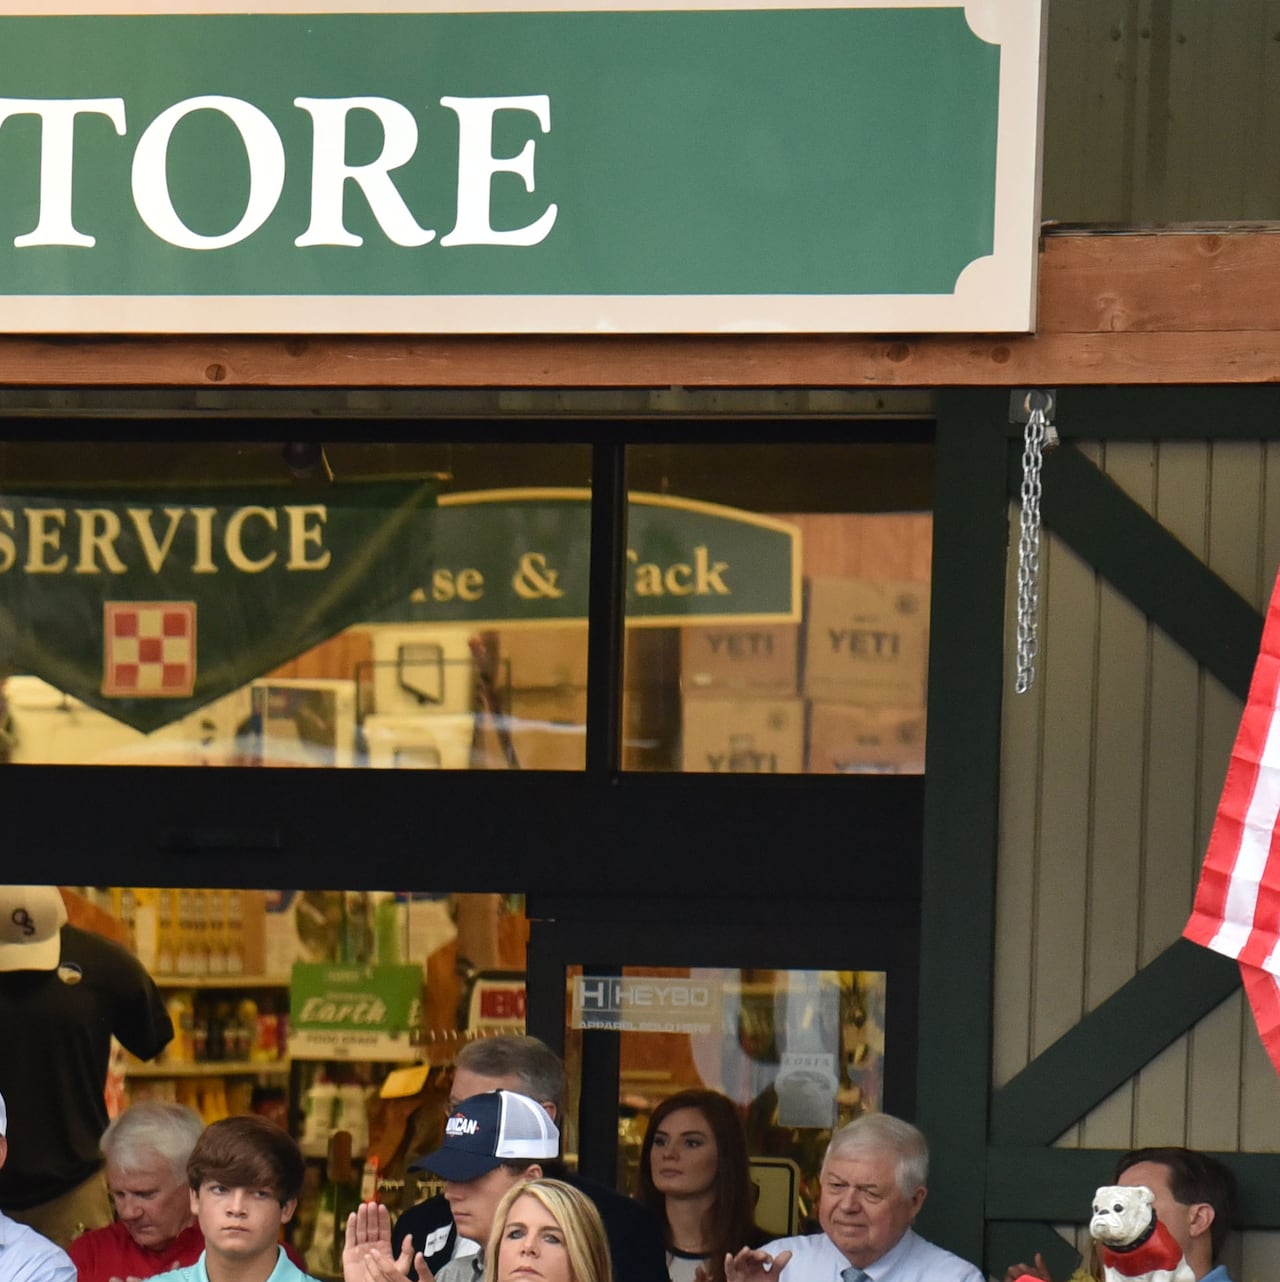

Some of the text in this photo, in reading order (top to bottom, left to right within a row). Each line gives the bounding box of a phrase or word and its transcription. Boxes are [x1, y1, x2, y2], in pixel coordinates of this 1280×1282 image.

[512, 552, 564, 599] &
[627, 545, 733, 597] ack
[707, 632, 774, 658] YETI
[829, 628, 900, 656] YETI
[615, 984, 709, 1007] HEYBO
